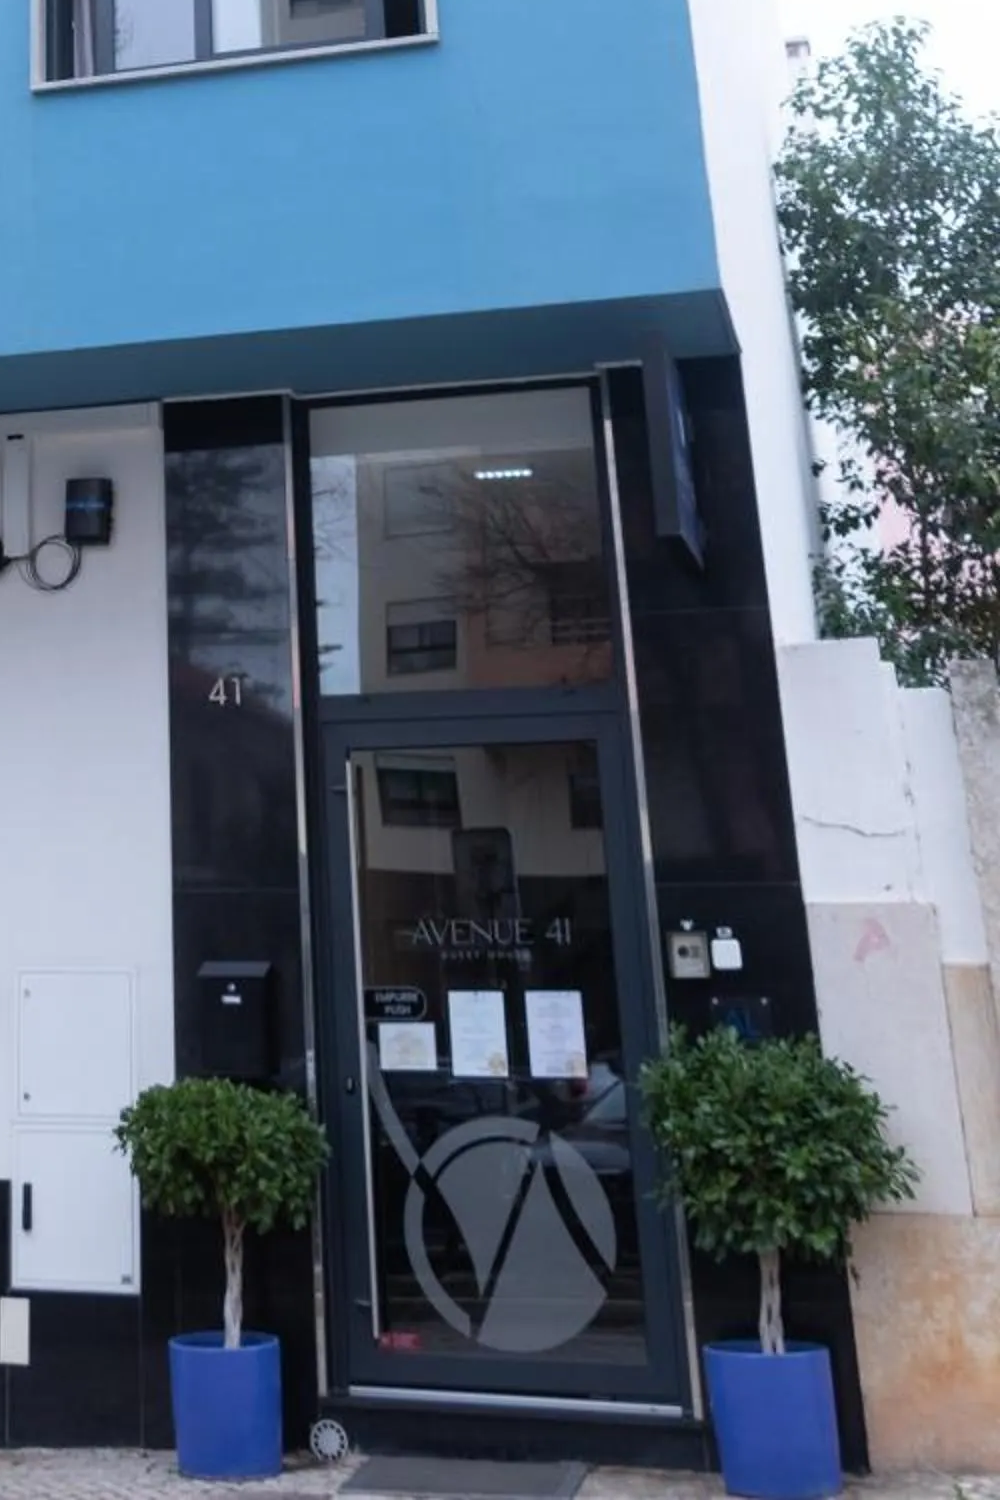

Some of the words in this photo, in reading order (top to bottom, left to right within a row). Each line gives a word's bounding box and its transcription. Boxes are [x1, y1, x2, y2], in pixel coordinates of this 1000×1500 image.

[208, 677, 242, 706] 41
[394, 917, 536, 946] AVENUE
[544, 916, 571, 946] 41
